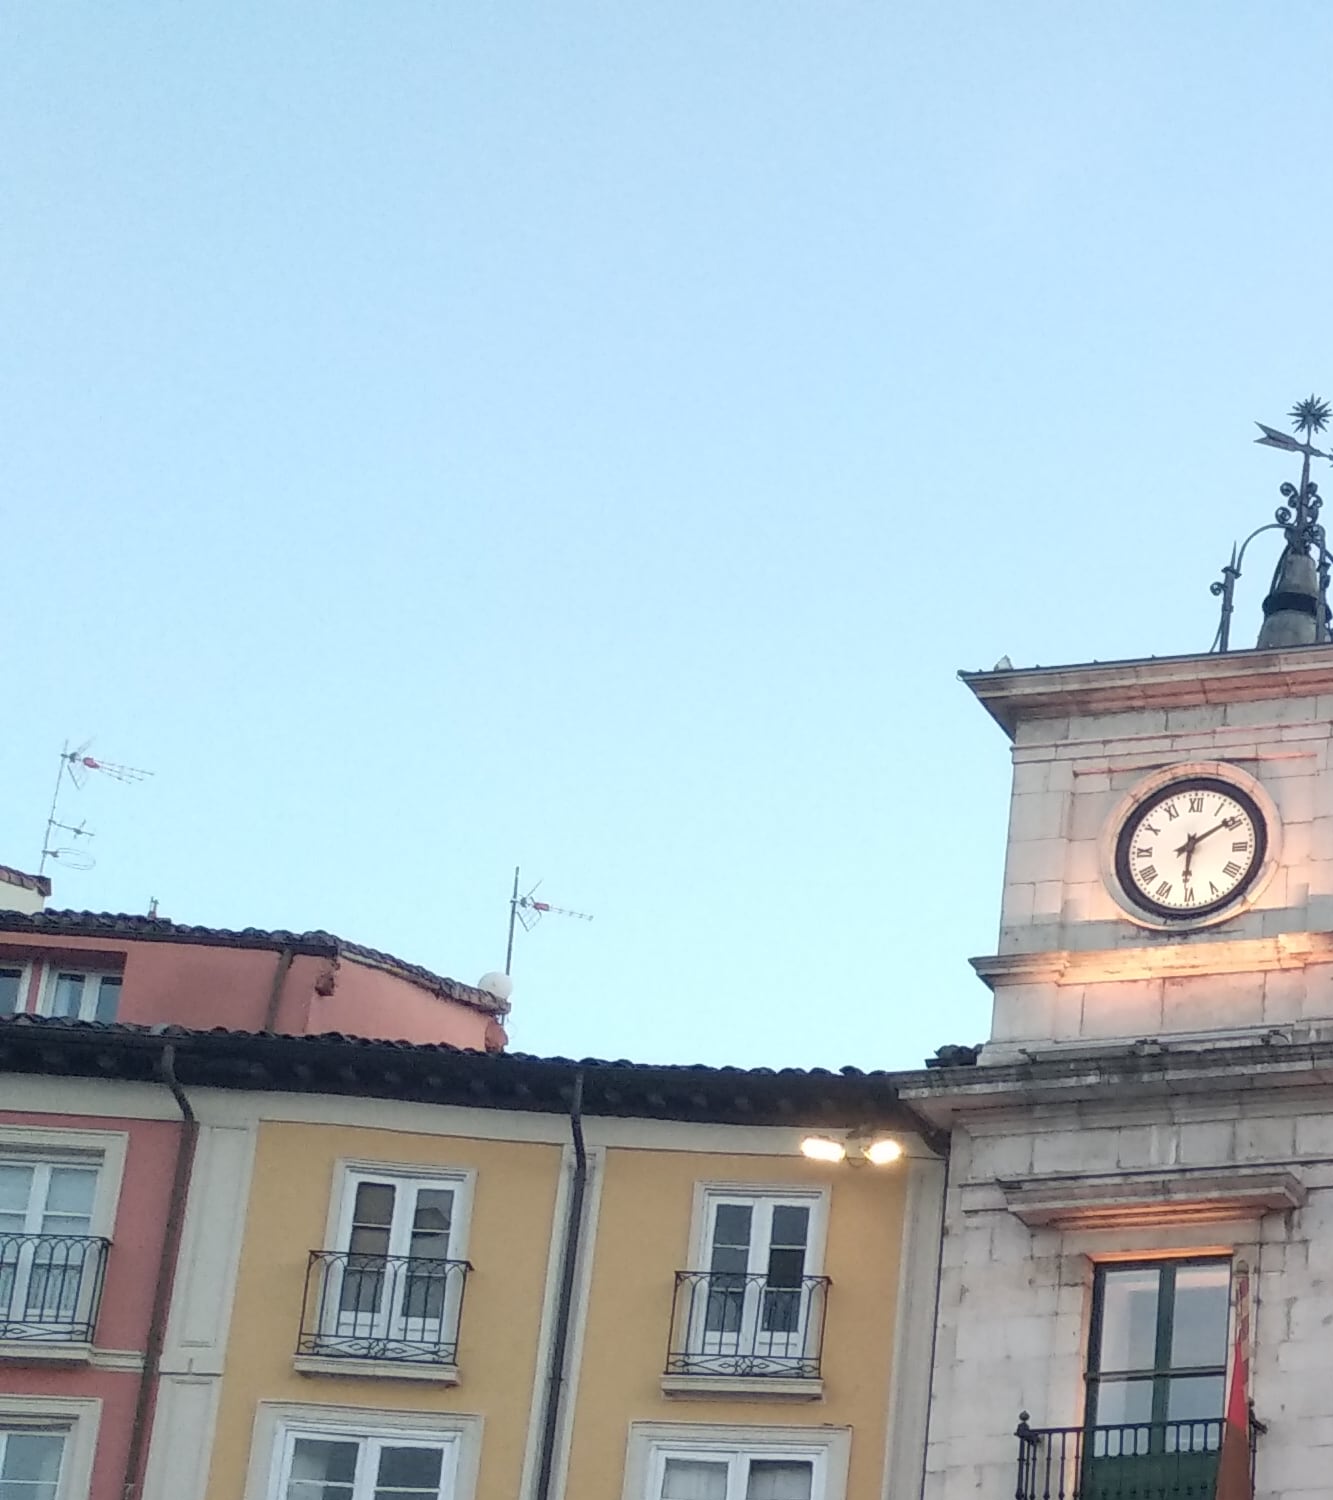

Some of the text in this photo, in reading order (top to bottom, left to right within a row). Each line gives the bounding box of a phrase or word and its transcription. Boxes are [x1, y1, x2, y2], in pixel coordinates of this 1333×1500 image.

[1163, 804, 1180, 821] XI
[1188, 798, 1204, 812] XII
[1214, 803, 1224, 816] I
[1144, 824, 1161, 836] X
[1136, 847, 1153, 858] IX
[1232, 841, 1248, 852] III
[1139, 865, 1159, 884] VIII
[1222, 861, 1241, 879] IIII
[1155, 881, 1173, 899] VII
[1184, 887, 1195, 902] VI
[1209, 881, 1219, 896] V
